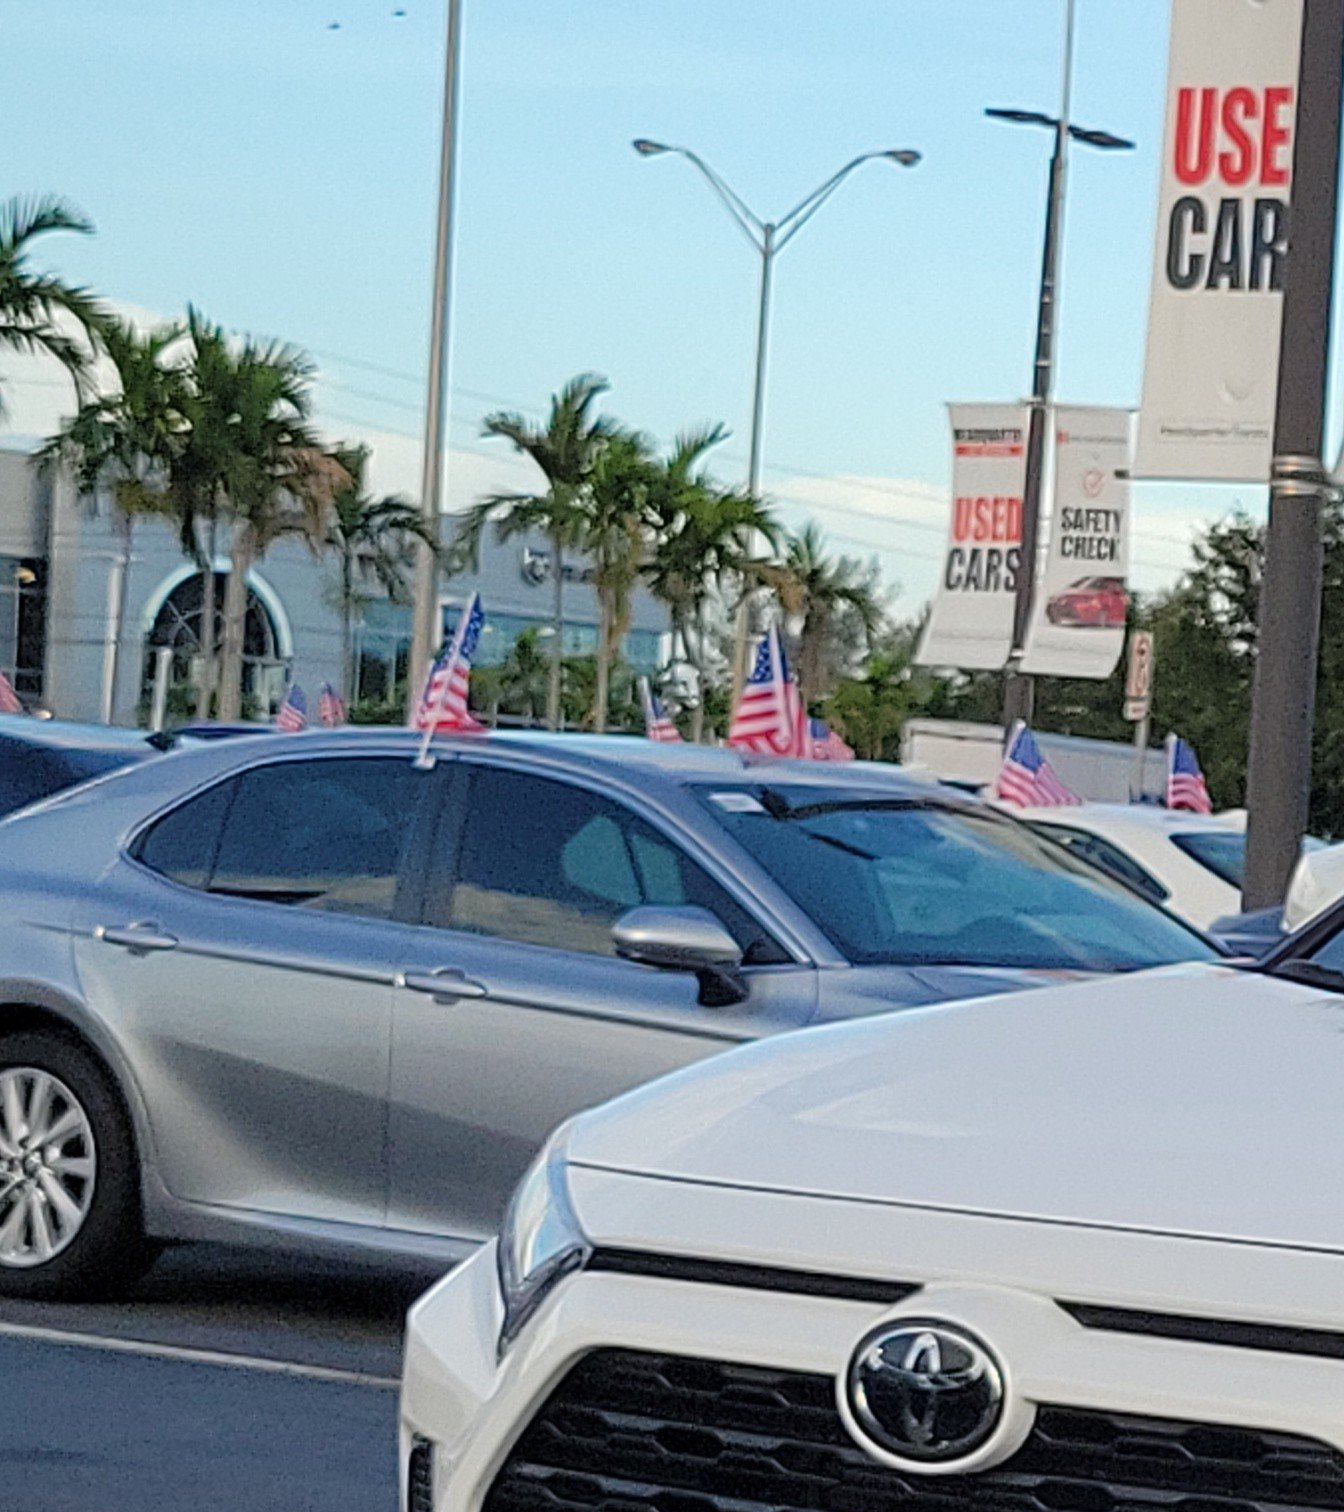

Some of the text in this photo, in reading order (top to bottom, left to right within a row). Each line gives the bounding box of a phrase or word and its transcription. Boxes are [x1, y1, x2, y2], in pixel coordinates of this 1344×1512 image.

[1173, 87, 1294, 187] USE
[1166, 196, 1292, 291] CAR
[953, 497, 1022, 542] USED
[945, 548, 1021, 592] CARS
